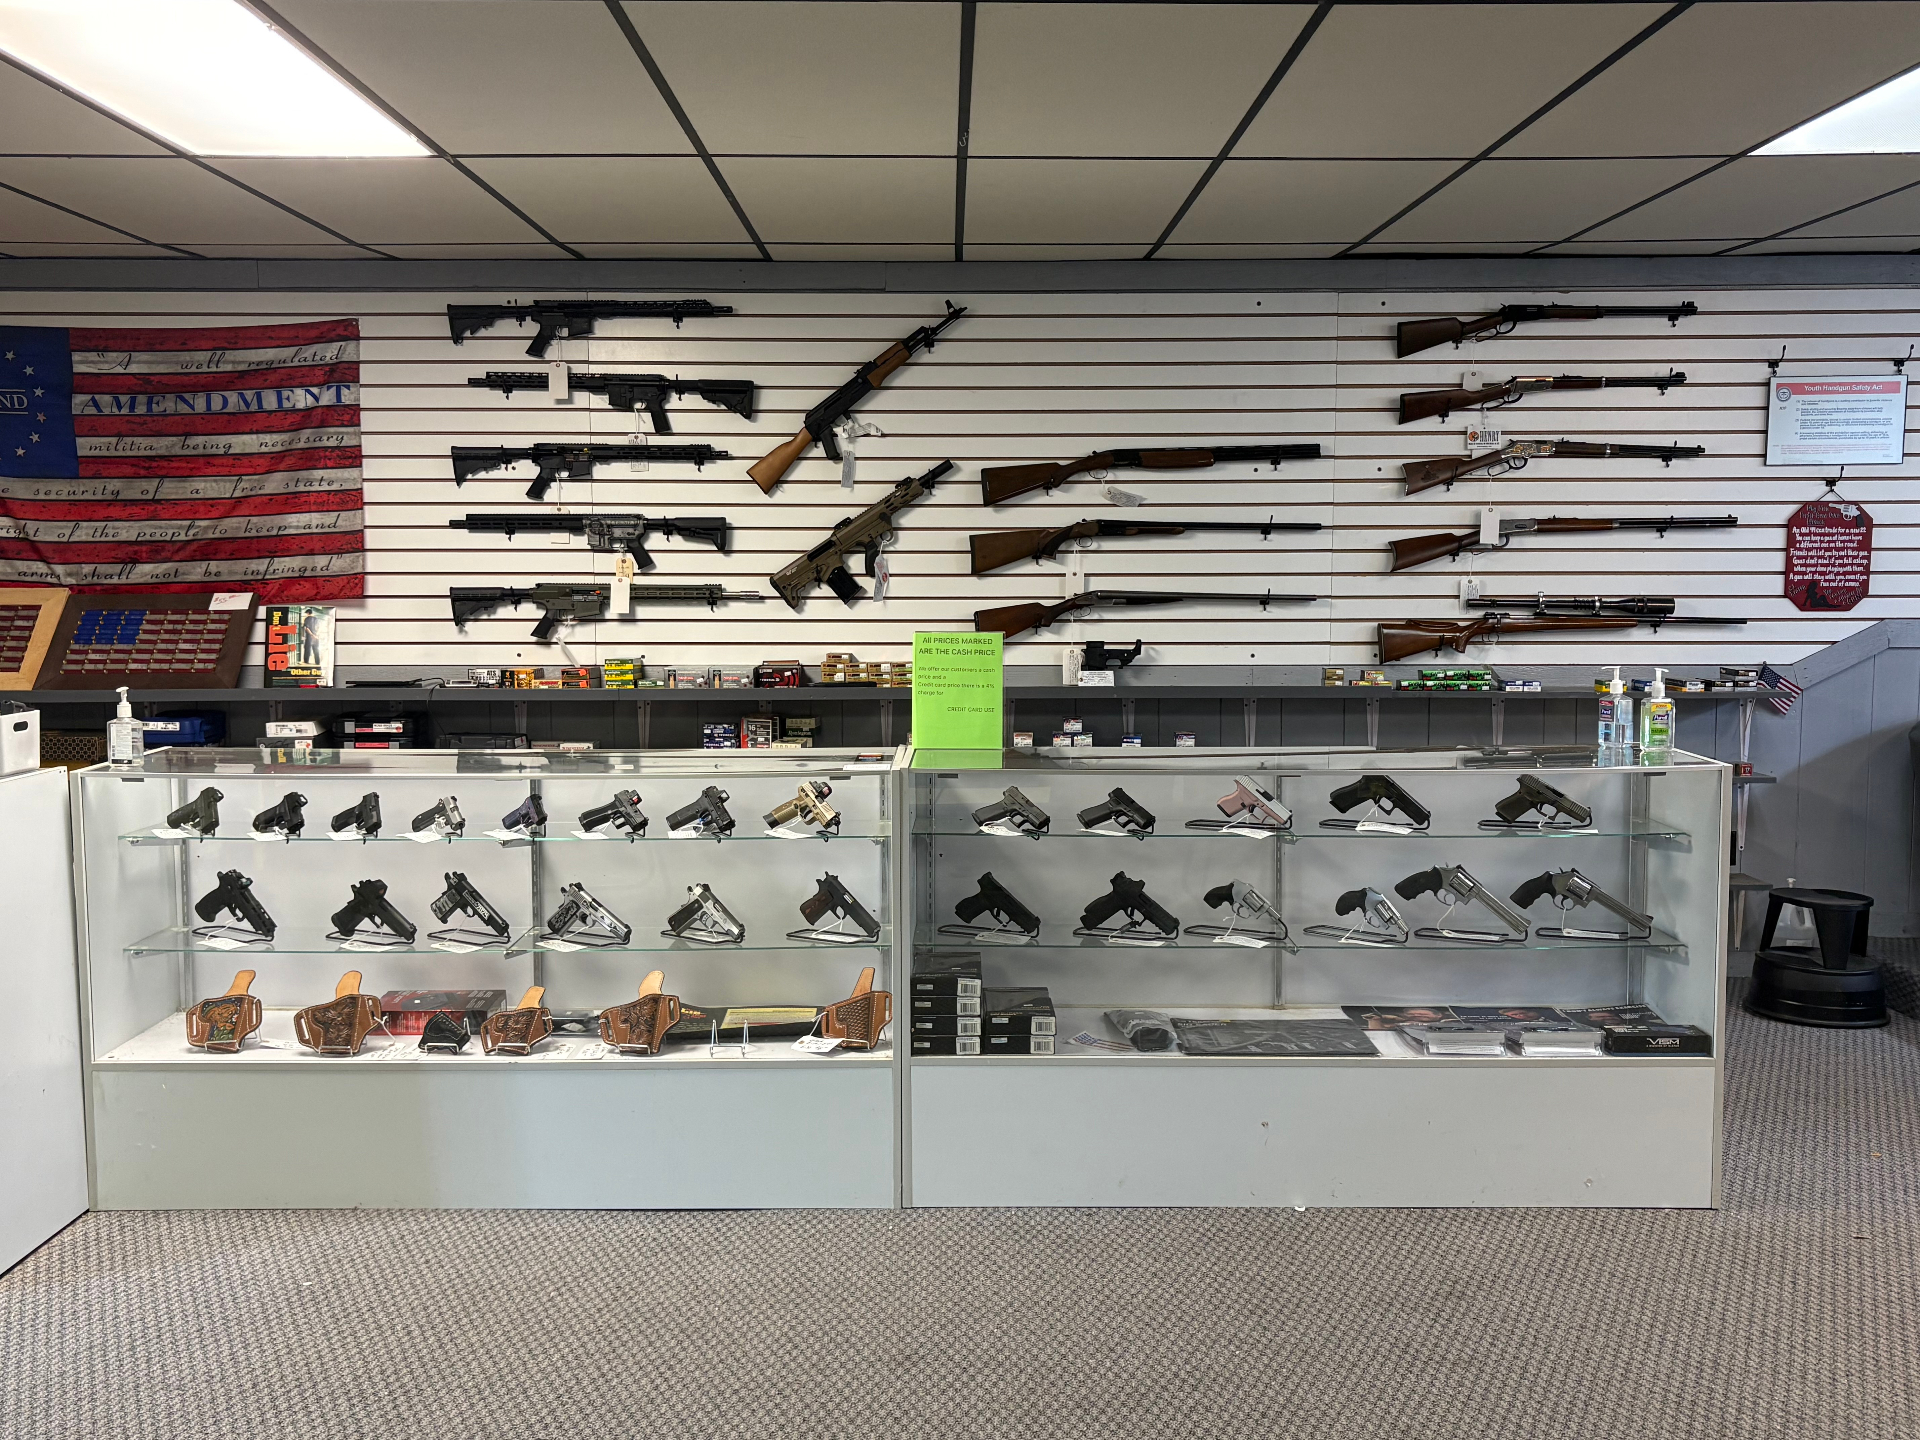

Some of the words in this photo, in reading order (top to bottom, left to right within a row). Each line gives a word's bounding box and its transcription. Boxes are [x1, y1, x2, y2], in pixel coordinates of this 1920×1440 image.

[181, 352, 225, 371] well
[247, 345, 344, 372] regulated
[81, 384, 351, 414] AMENDMENT
[1851, 384, 1871, 392] Safety
[89, 438, 156, 452] militia
[181, 436, 233, 455] being
[259, 433, 345, 449] necessary
[1480, 431, 1500, 442] HENRY
[33, 485, 120, 500] security
[141, 478, 165, 500] of
[230, 476, 266, 498] free
[283, 477, 345, 490] state,
[57, 522, 80, 542] of
[92, 524, 120, 538] the
[135, 520, 199, 542] people
[211, 524, 228, 535] to
[243, 518, 287, 537] keep
[303, 513, 341, 531] and
[17, 570, 60, 580] arms
[82, 563, 137, 580] shall
[150, 568, 180, 580] not
[204, 563, 222, 579] be
[244, 553, 343, 580] infringed"
[267, 624, 297, 671] Lie
[933, 637, 960, 645] PRICES
[290, 668, 310, 676] Other
